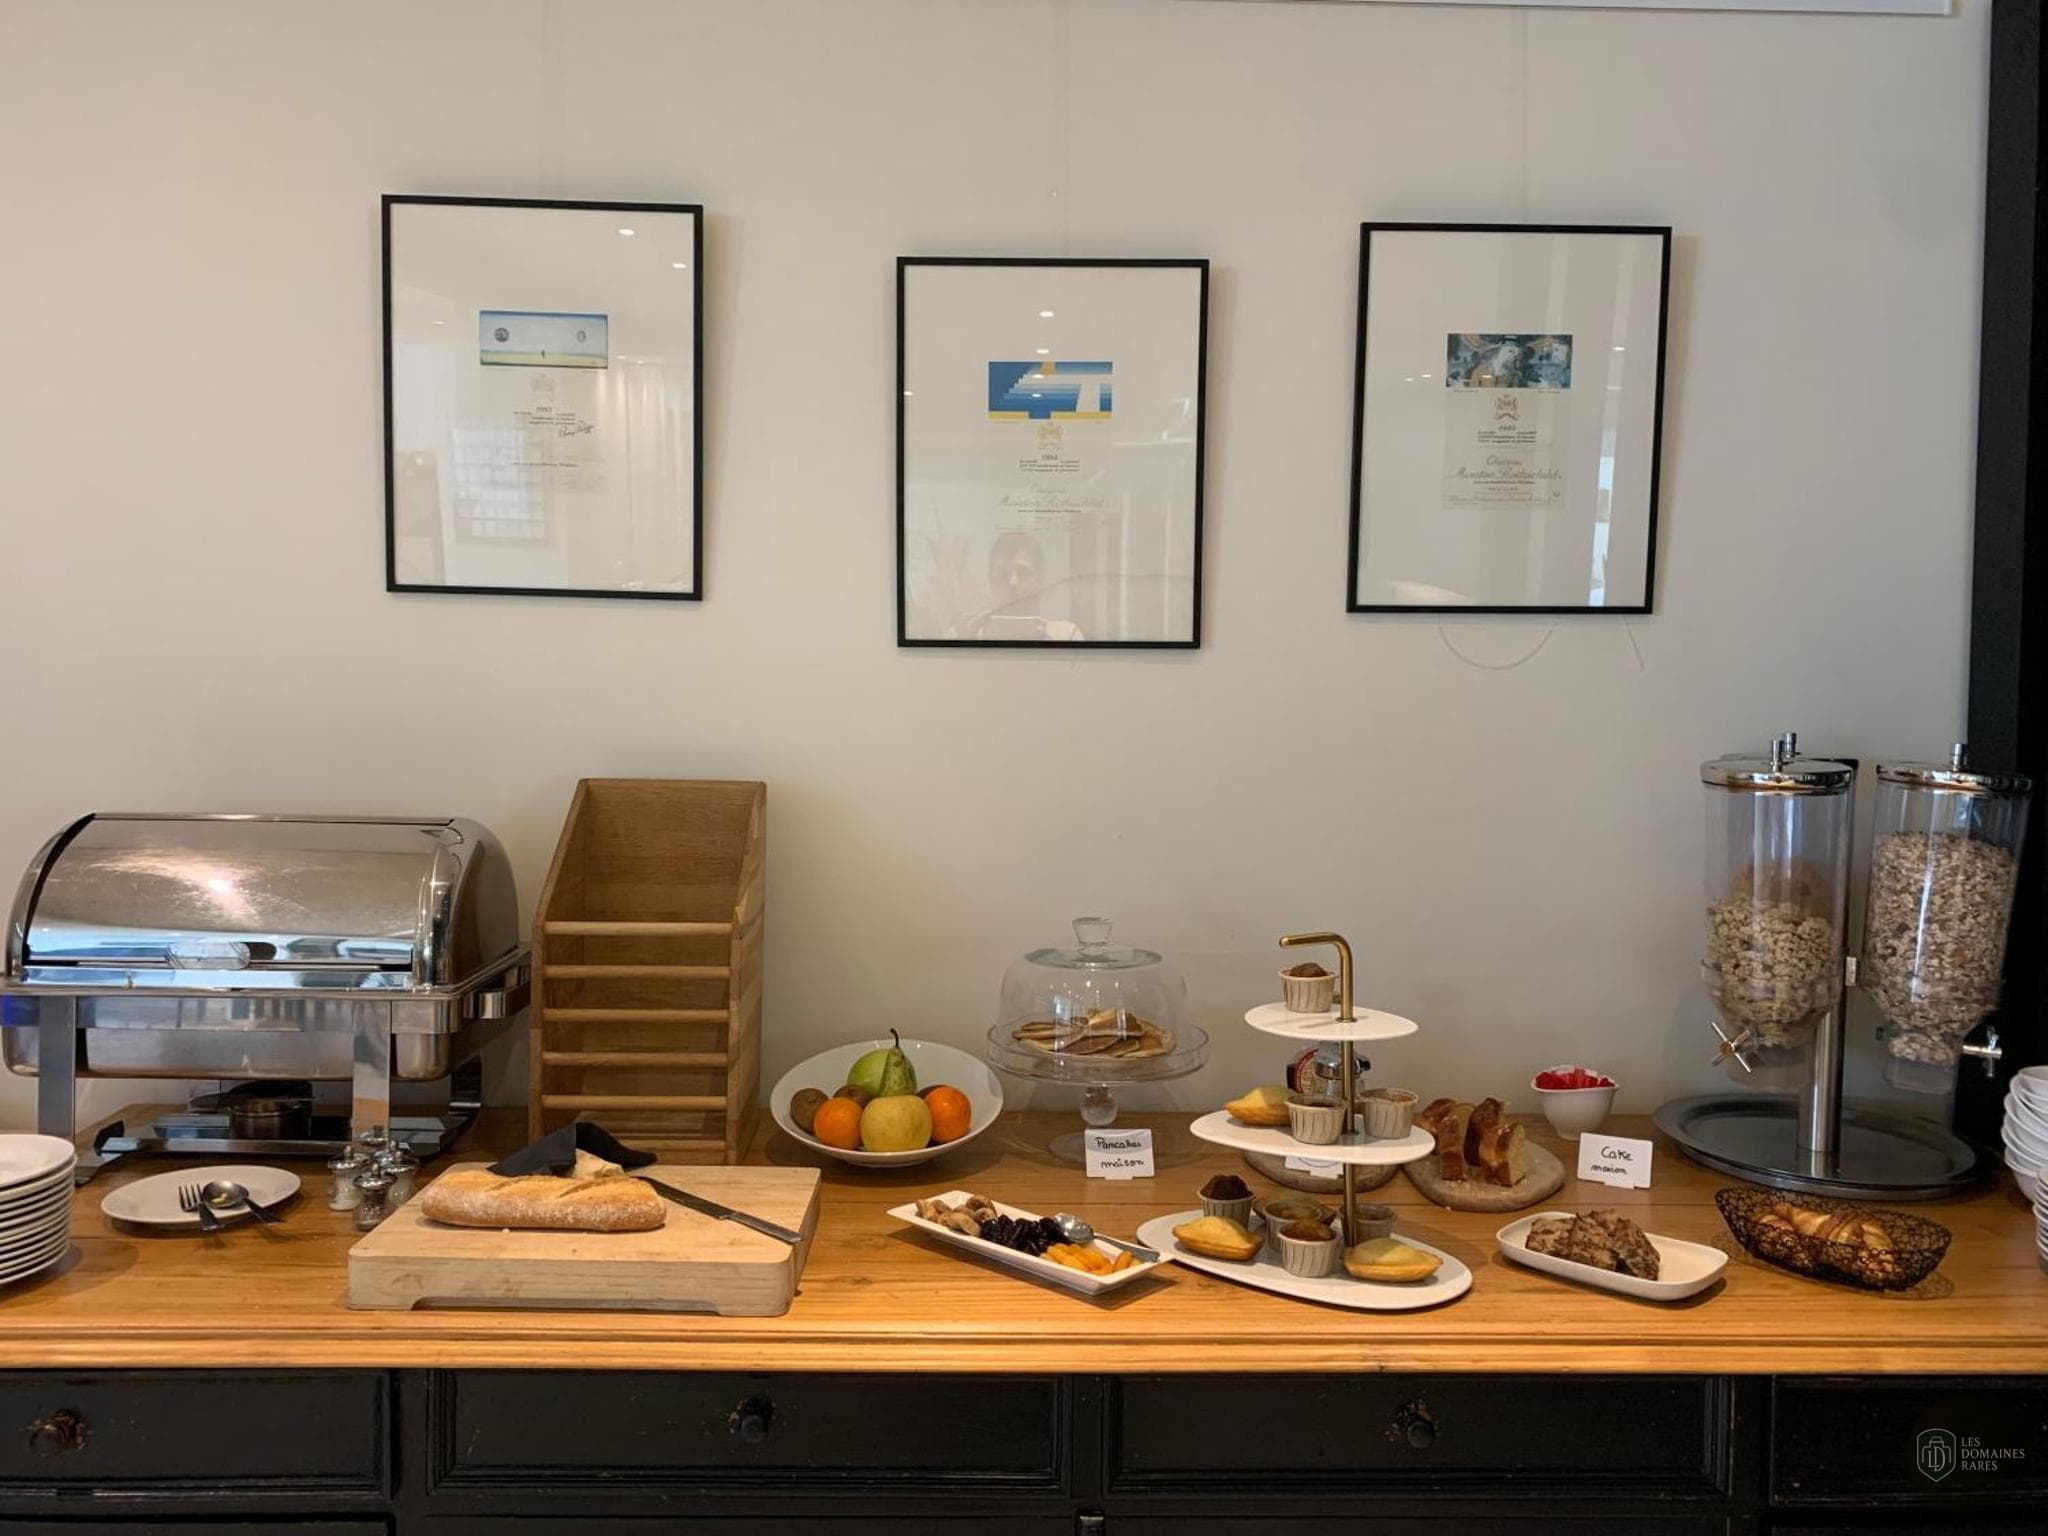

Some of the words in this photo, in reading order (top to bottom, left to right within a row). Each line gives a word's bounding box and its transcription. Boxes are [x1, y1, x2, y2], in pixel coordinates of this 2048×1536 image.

[1094, 1136, 1142, 1150] Pancakes
[1600, 1145, 1634, 1161] Cake
[1100, 1158, 1145, 1169] maison
[1590, 1163, 1628, 1175] maison
